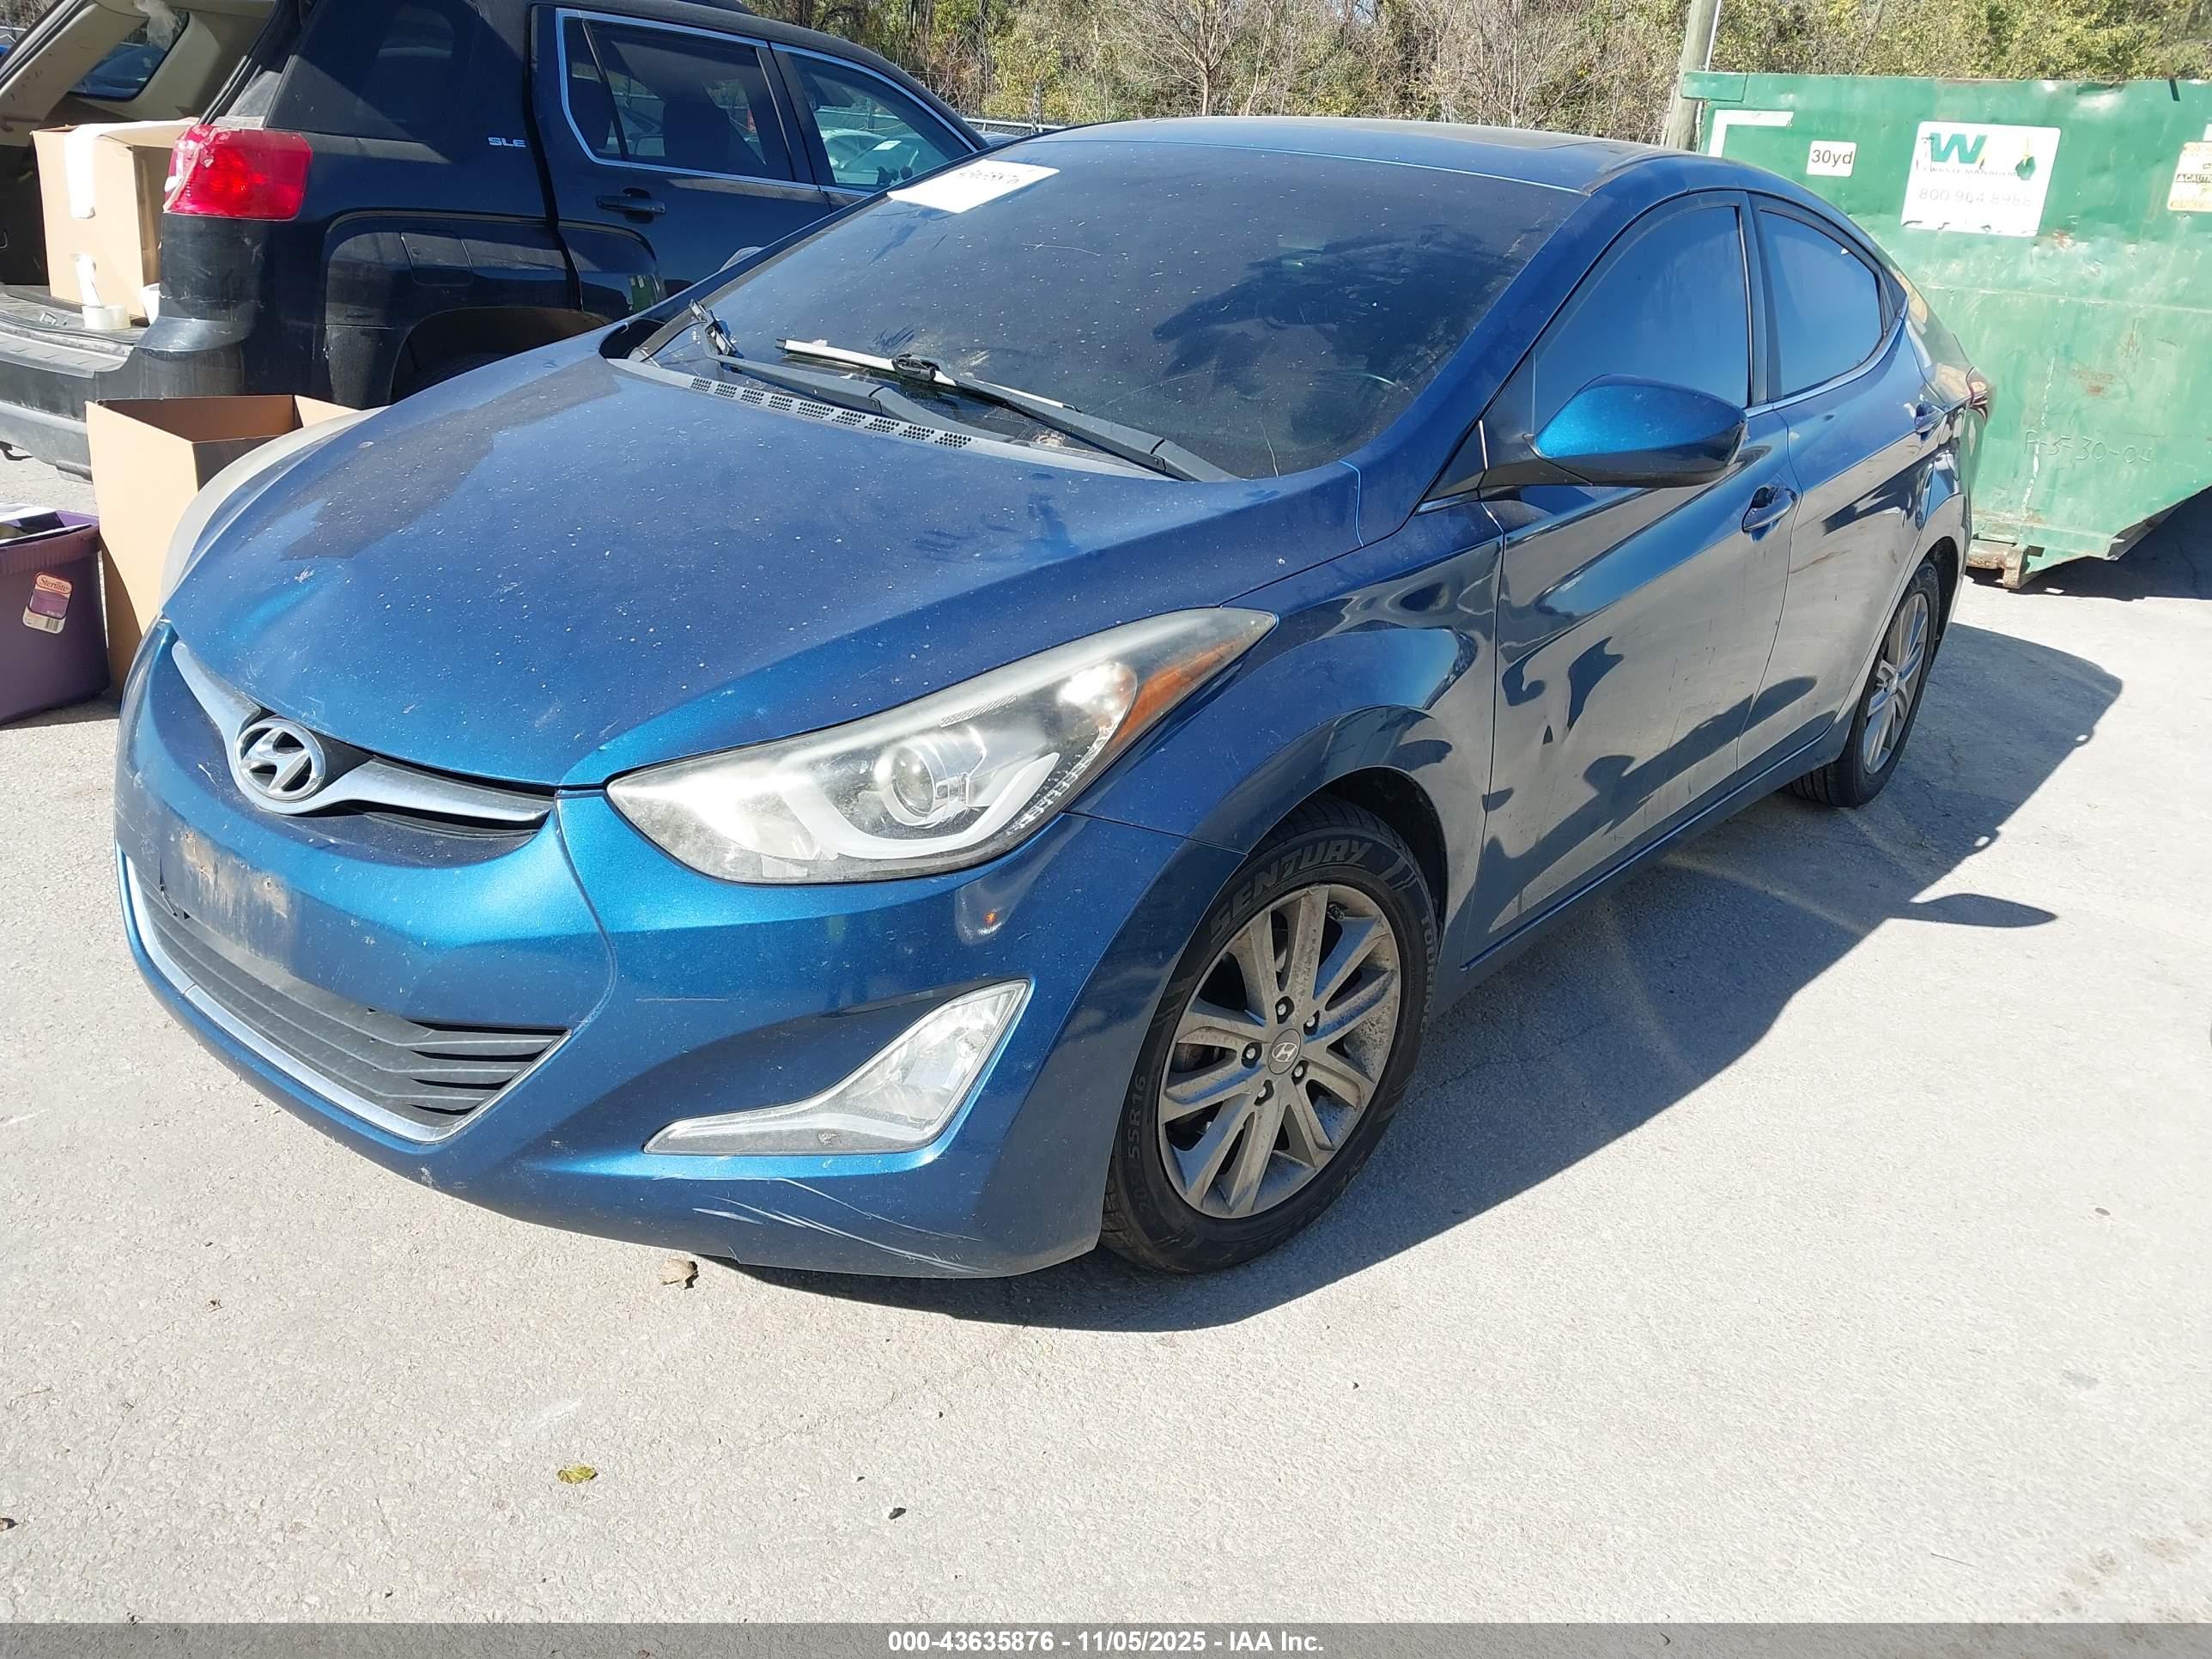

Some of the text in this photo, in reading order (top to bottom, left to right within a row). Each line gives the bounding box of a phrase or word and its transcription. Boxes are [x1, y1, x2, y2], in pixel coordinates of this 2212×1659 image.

[488, 137, 526, 148] SLE
[1811, 149, 1854, 167] 30yd
[1918, 187, 1951, 202] 800
[39, 575, 68, 592] Sterilite
